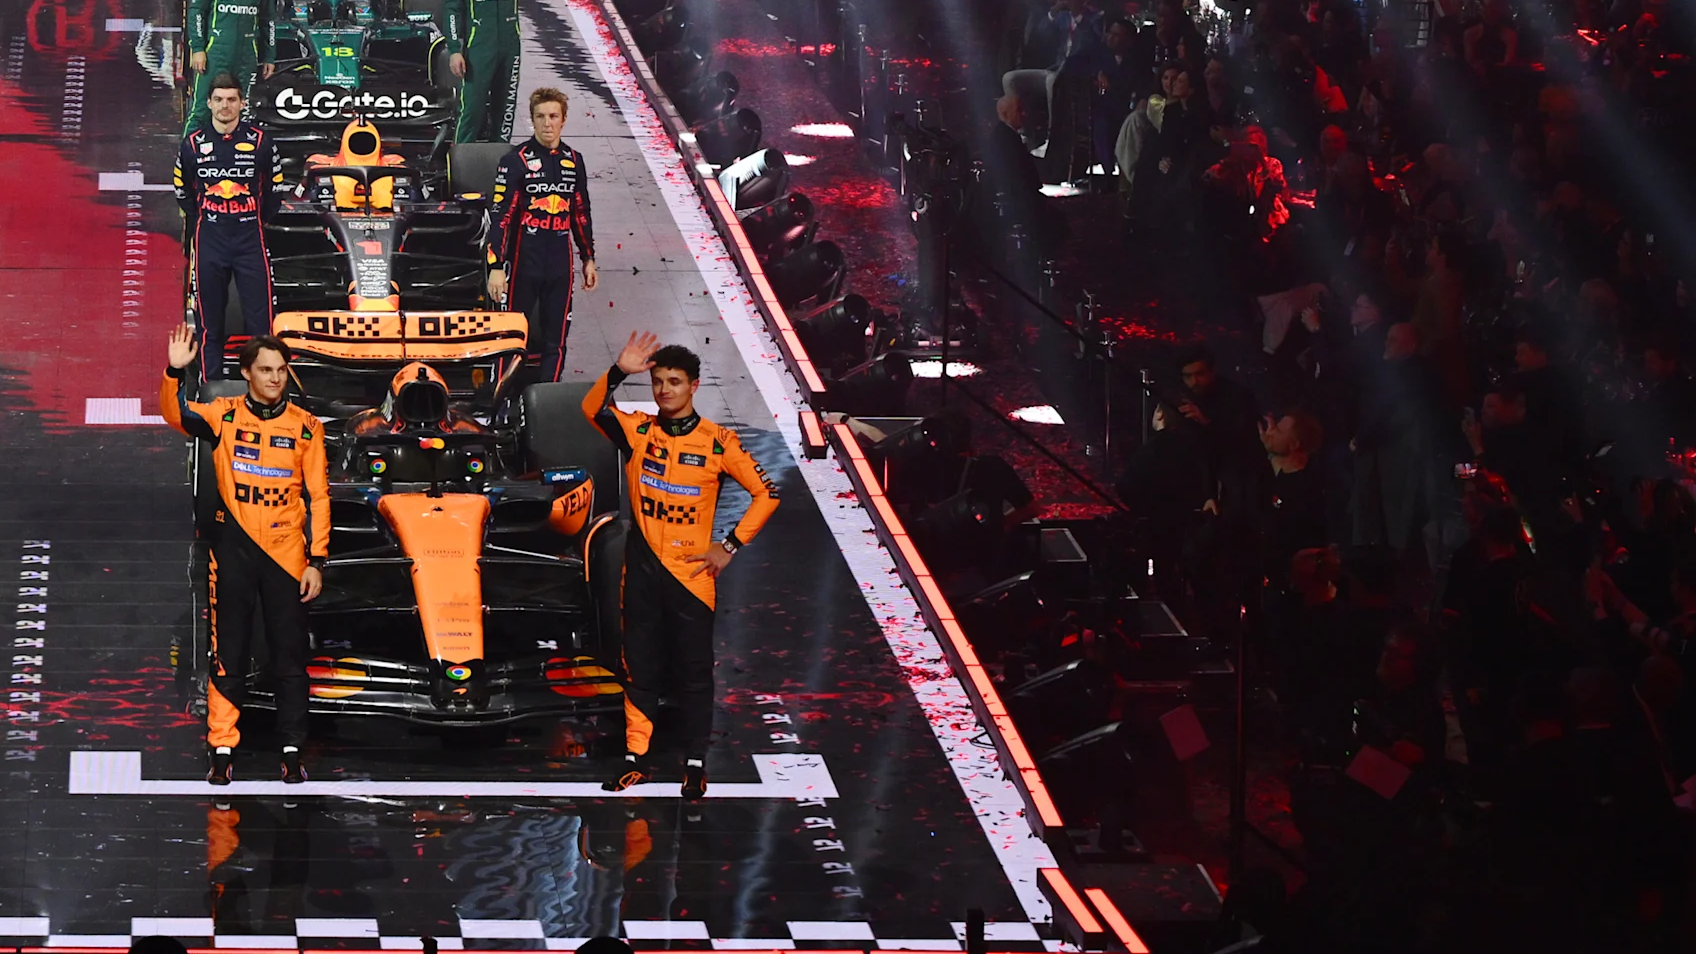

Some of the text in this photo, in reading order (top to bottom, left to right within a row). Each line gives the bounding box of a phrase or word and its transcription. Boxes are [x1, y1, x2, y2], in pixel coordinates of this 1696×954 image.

[217, 3, 258, 15] aramco
[321, 46, 354, 57] 18
[312, 90, 429, 119] Gate.io
[500, 55, 520, 141] ASTON MARTIN
[197, 168, 255, 178] ORACLE
[526, 183, 575, 193] ORACLE
[202, 196, 257, 214] Red Bull
[522, 211, 551, 230] Red
[308, 317, 380, 337] OKX
[418, 316, 491, 337] OKX
[233, 461, 252, 472] DELL
[552, 473, 574, 482] allwyn
[640, 475, 659, 487] DELL
[234, 483, 290, 507] OKX
[641, 495, 696, 524] OKX
